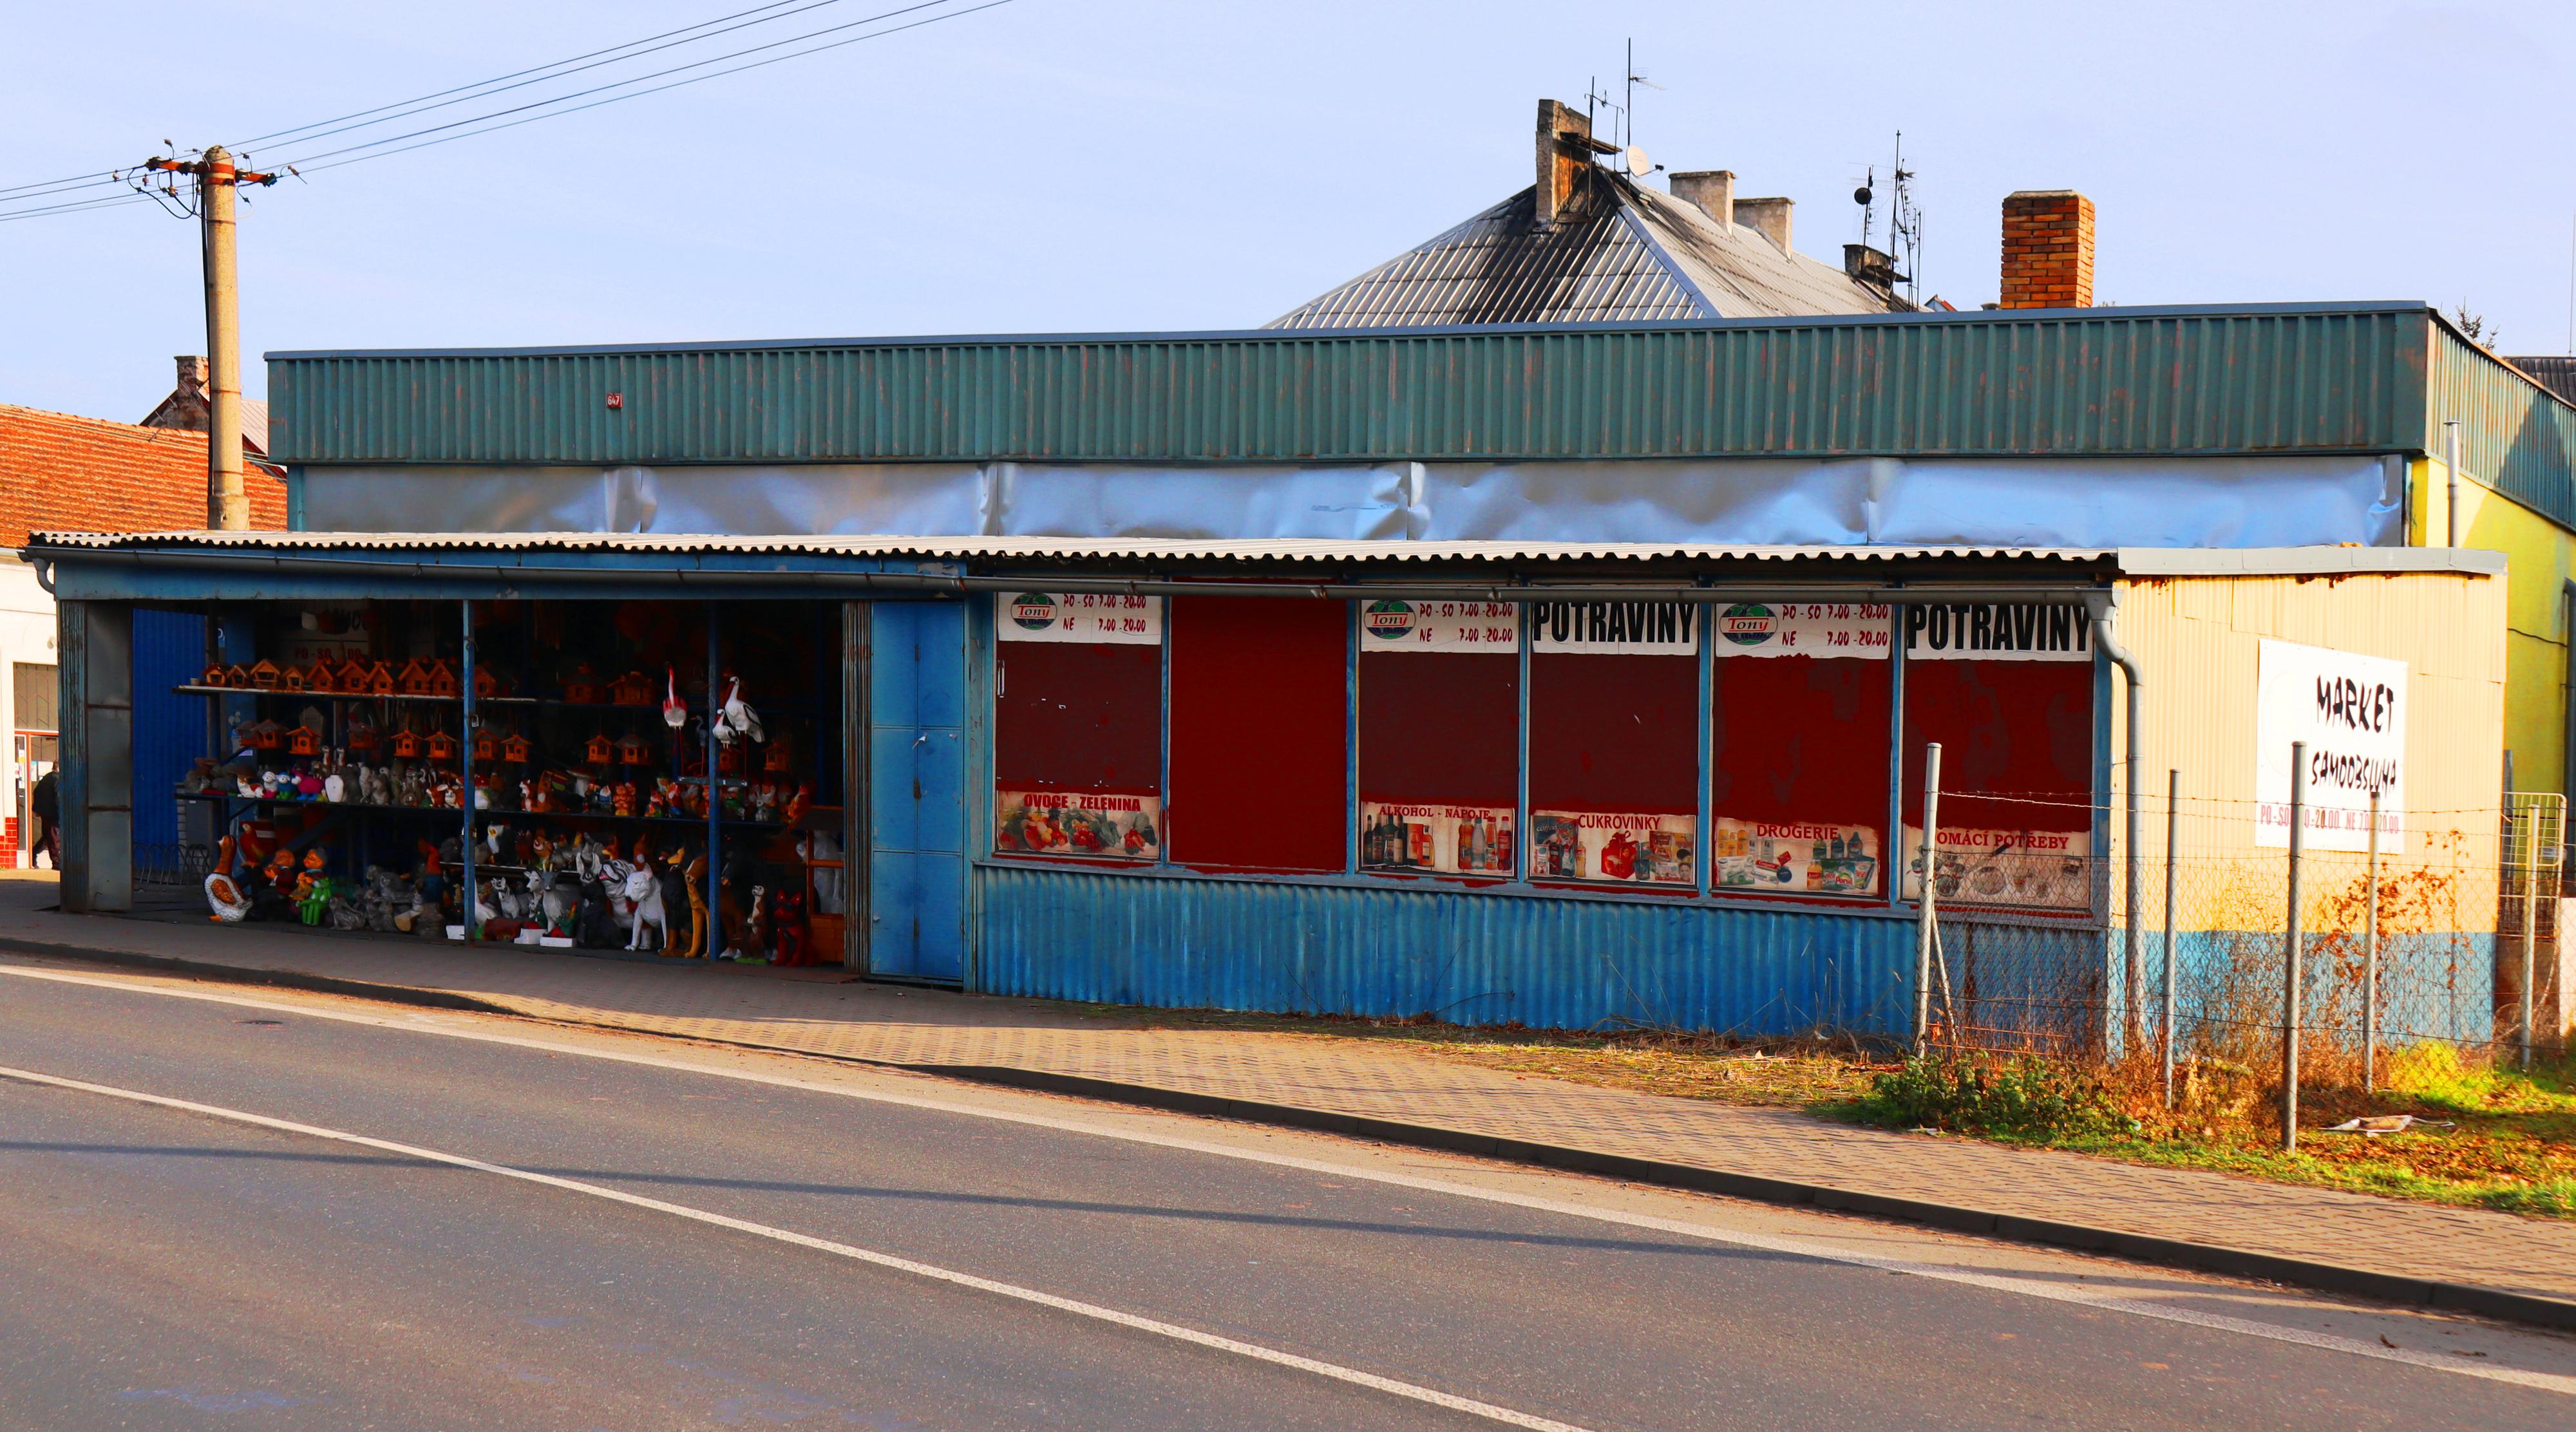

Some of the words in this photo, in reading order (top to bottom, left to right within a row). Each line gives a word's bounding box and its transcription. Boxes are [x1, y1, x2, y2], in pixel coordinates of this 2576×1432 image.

[607, 395, 620, 406] 647
[1063, 594, 1075, 608] PO
[1083, 594, 1094, 608] SO
[1018, 605, 1050, 617] Tony
[1419, 603, 1432, 618] PO
[1442, 603, 1454, 617] SO
[1782, 604, 1796, 620] PO
[1807, 604, 1821, 619] SO
[1063, 617, 1075, 631] NE
[1372, 613, 1408, 626] Tony
[1533, 602, 1696, 643] POTRAVINY
[1728, 617, 1769, 632] Tony
[1419, 628, 1432, 643] NE
[1908, 605, 2090, 652] POTRAVINY
[1781, 630, 1797, 646] NE
[2316, 674, 2394, 735] MARKET
[2311, 750, 2396, 799] SAMOOBSLUHA
[1023, 794, 1068, 808] OVOCE
[1079, 796, 1141, 811] ZELENINA
[1379, 806, 1434, 817] ALKOHOL
[1444, 807, 1491, 820] NÁPOJE
[2260, 804, 2271, 825] PO
[2278, 806, 2289, 827] SO
[2346, 812, 2355, 831] NE
[1578, 815, 1662, 830] CUKROVINKY
[1756, 824, 1839, 840] DROGERIE
[1935, 829, 1989, 847] OMÁCÍ
[1994, 832, 2069, 849] POTŘEBY
